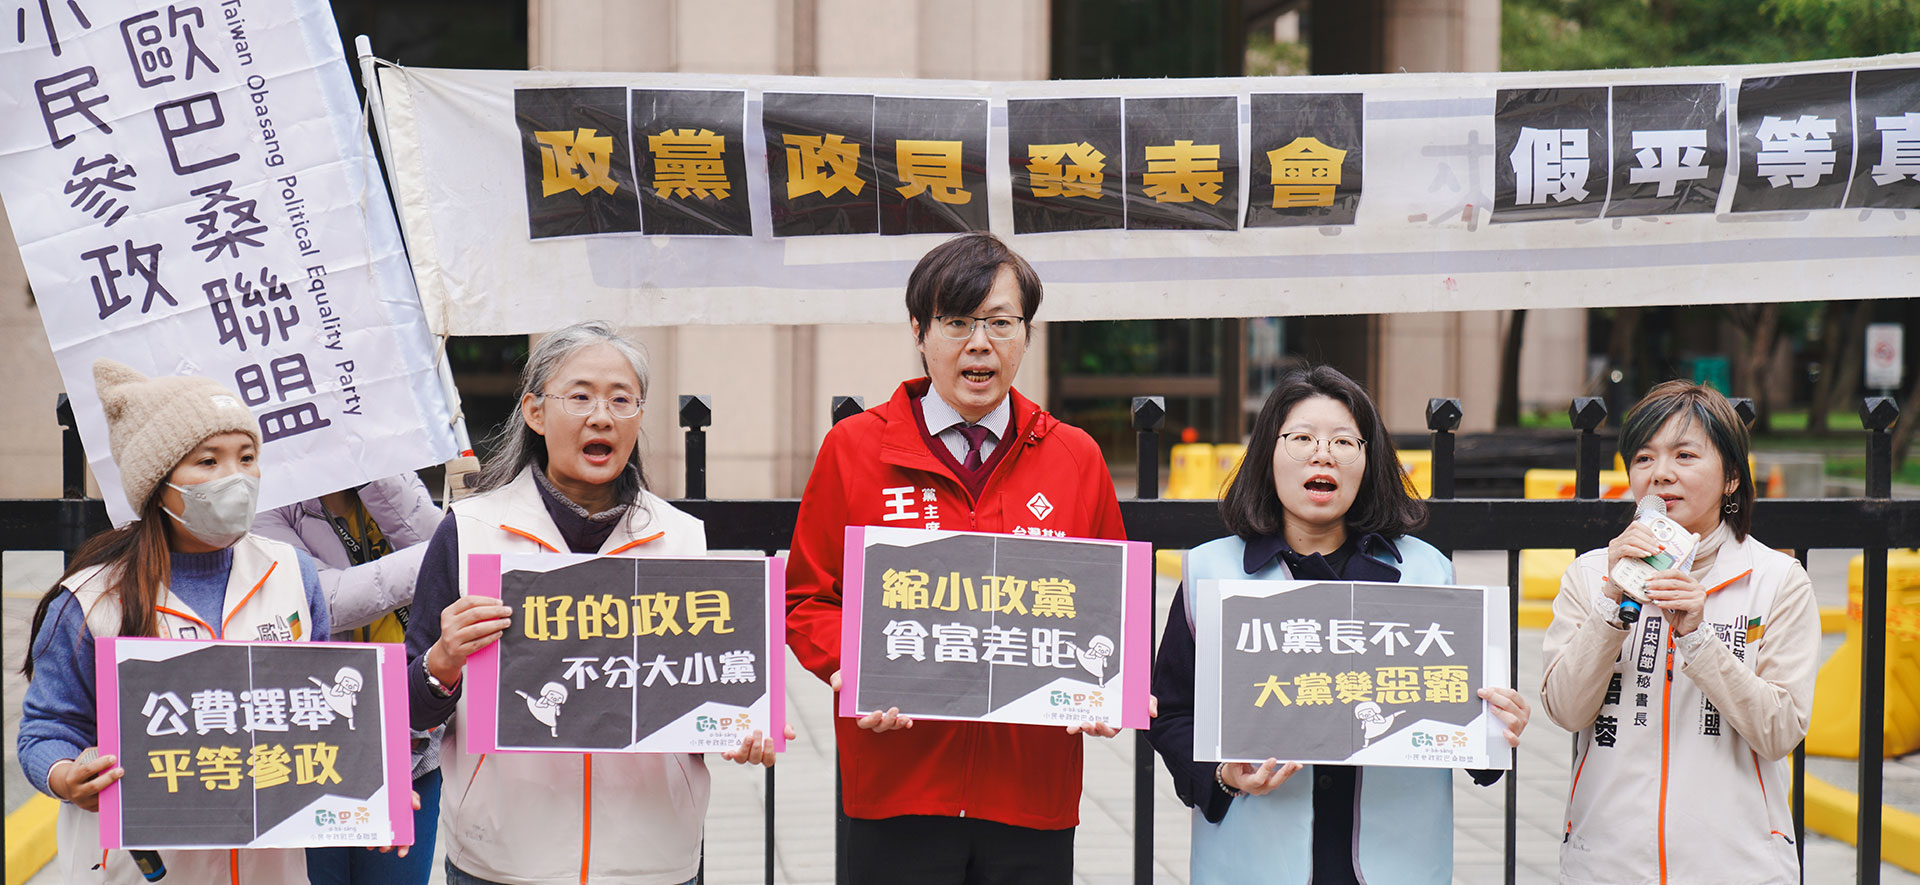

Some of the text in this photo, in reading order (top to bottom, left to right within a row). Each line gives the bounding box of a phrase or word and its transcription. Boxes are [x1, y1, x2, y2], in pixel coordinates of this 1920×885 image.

[533, 127, 1347, 208] 政黨政見發表會
[119, 4, 331, 443] 歐巴桑聯盟
[221, 0, 362, 415] Taiwan Obasang Political Equality Party
[522, 590, 735, 641] 好的政見
[881, 568, 1077, 619] 縮小政黨
[881, 619, 1077, 669] 貧富差距
[1235, 618, 1456, 657] 小黨長不大
[562, 650, 757, 690] 不分大小黨
[1253, 665, 1469, 708] 大黨變惡霸
[140, 687, 337, 737] 公費選舉
[1633, 674, 1651, 727] 秘書長
[147, 741, 343, 794] 平等參政
